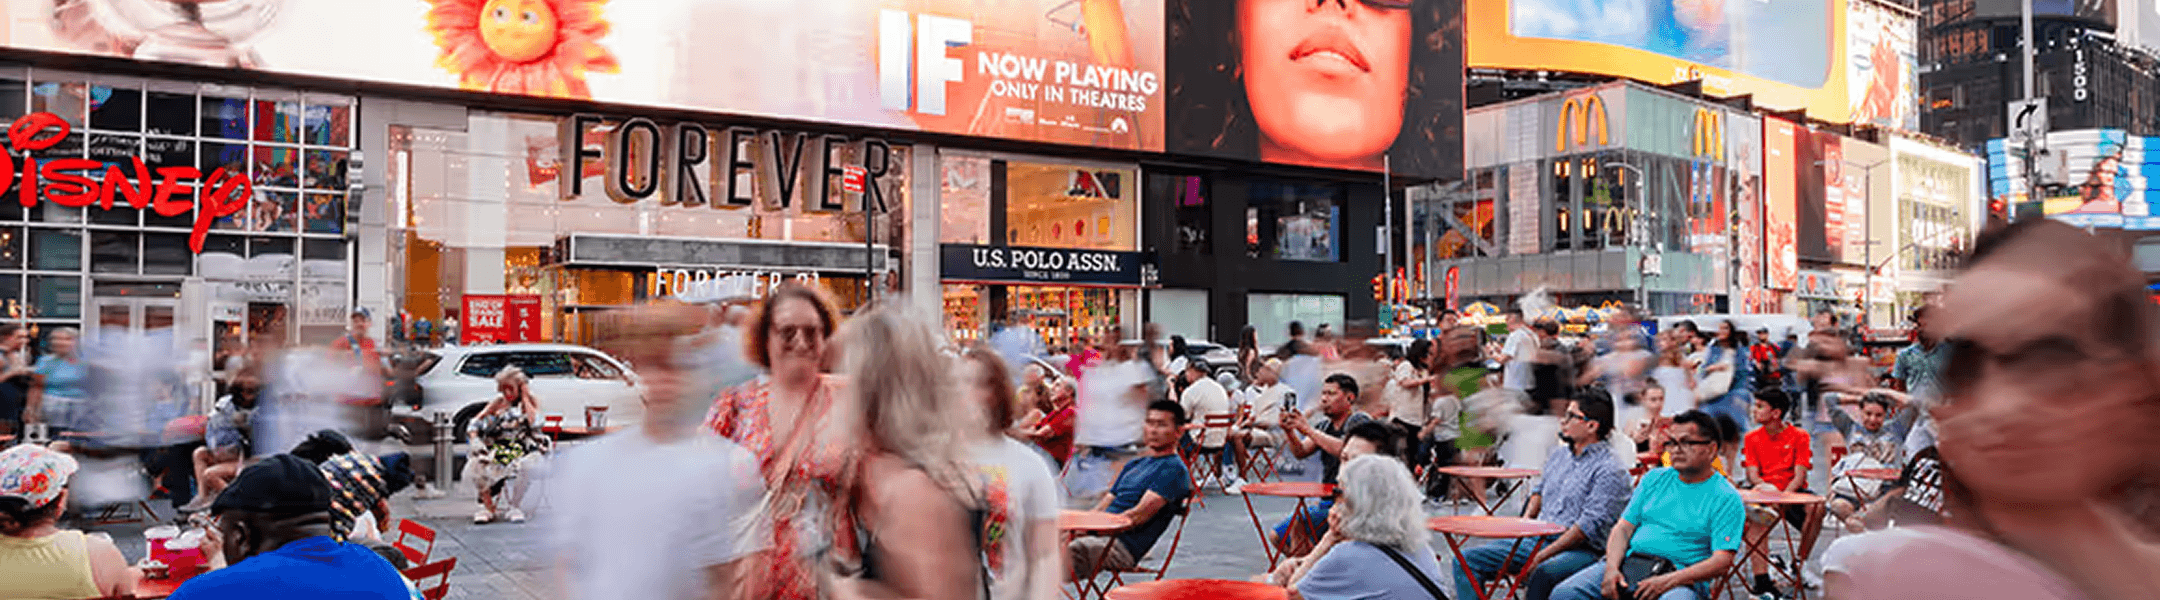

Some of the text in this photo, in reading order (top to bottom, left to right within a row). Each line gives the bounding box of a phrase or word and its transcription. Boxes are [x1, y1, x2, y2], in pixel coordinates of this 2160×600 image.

[879, 9, 972, 116] IF
[978, 51, 1158, 95] NOW PLAYING
[992, 80, 1146, 112] ONLY IN THEATRES
[0, 111, 252, 254] ISNEY
[560, 113, 888, 214] FOREVER
[973, 248, 1121, 272] U.S. POLO ASSN.
[469, 315, 504, 328] SALE
[519, 307, 529, 341] SAL
